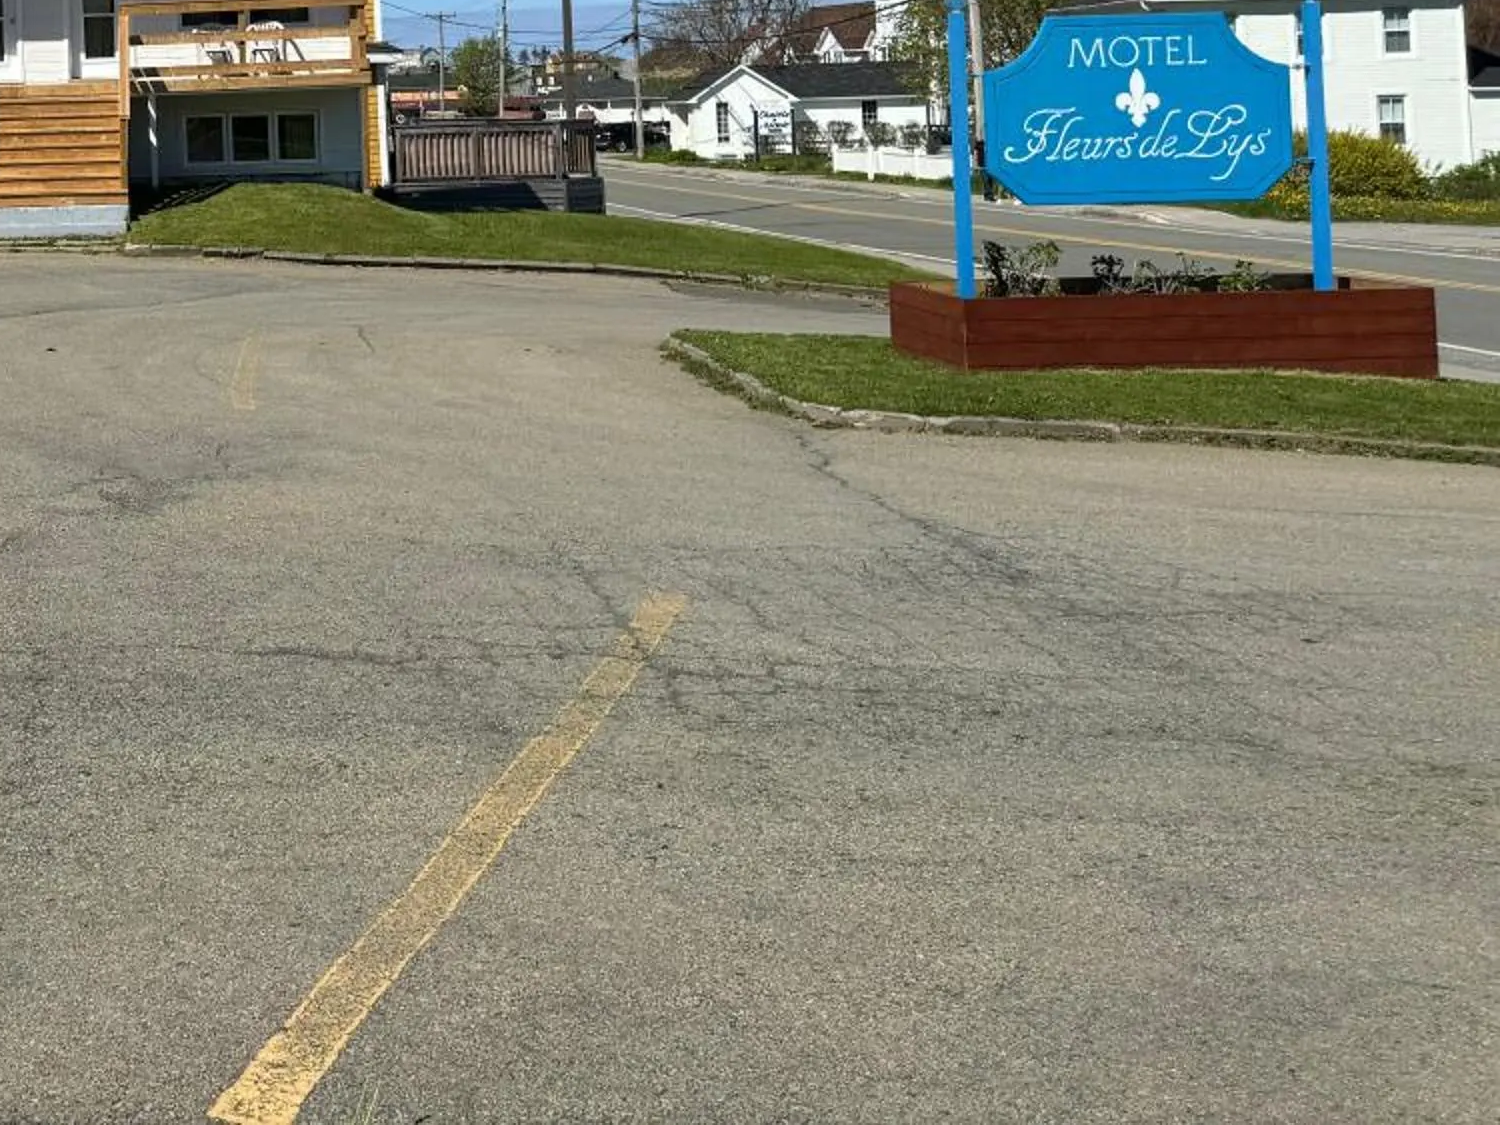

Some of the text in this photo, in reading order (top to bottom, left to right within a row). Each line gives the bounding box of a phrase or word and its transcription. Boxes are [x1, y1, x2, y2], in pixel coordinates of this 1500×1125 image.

[1068, 35, 1208, 68] MOTEL
[1003, 103, 1271, 180] Fleurs de Lys
